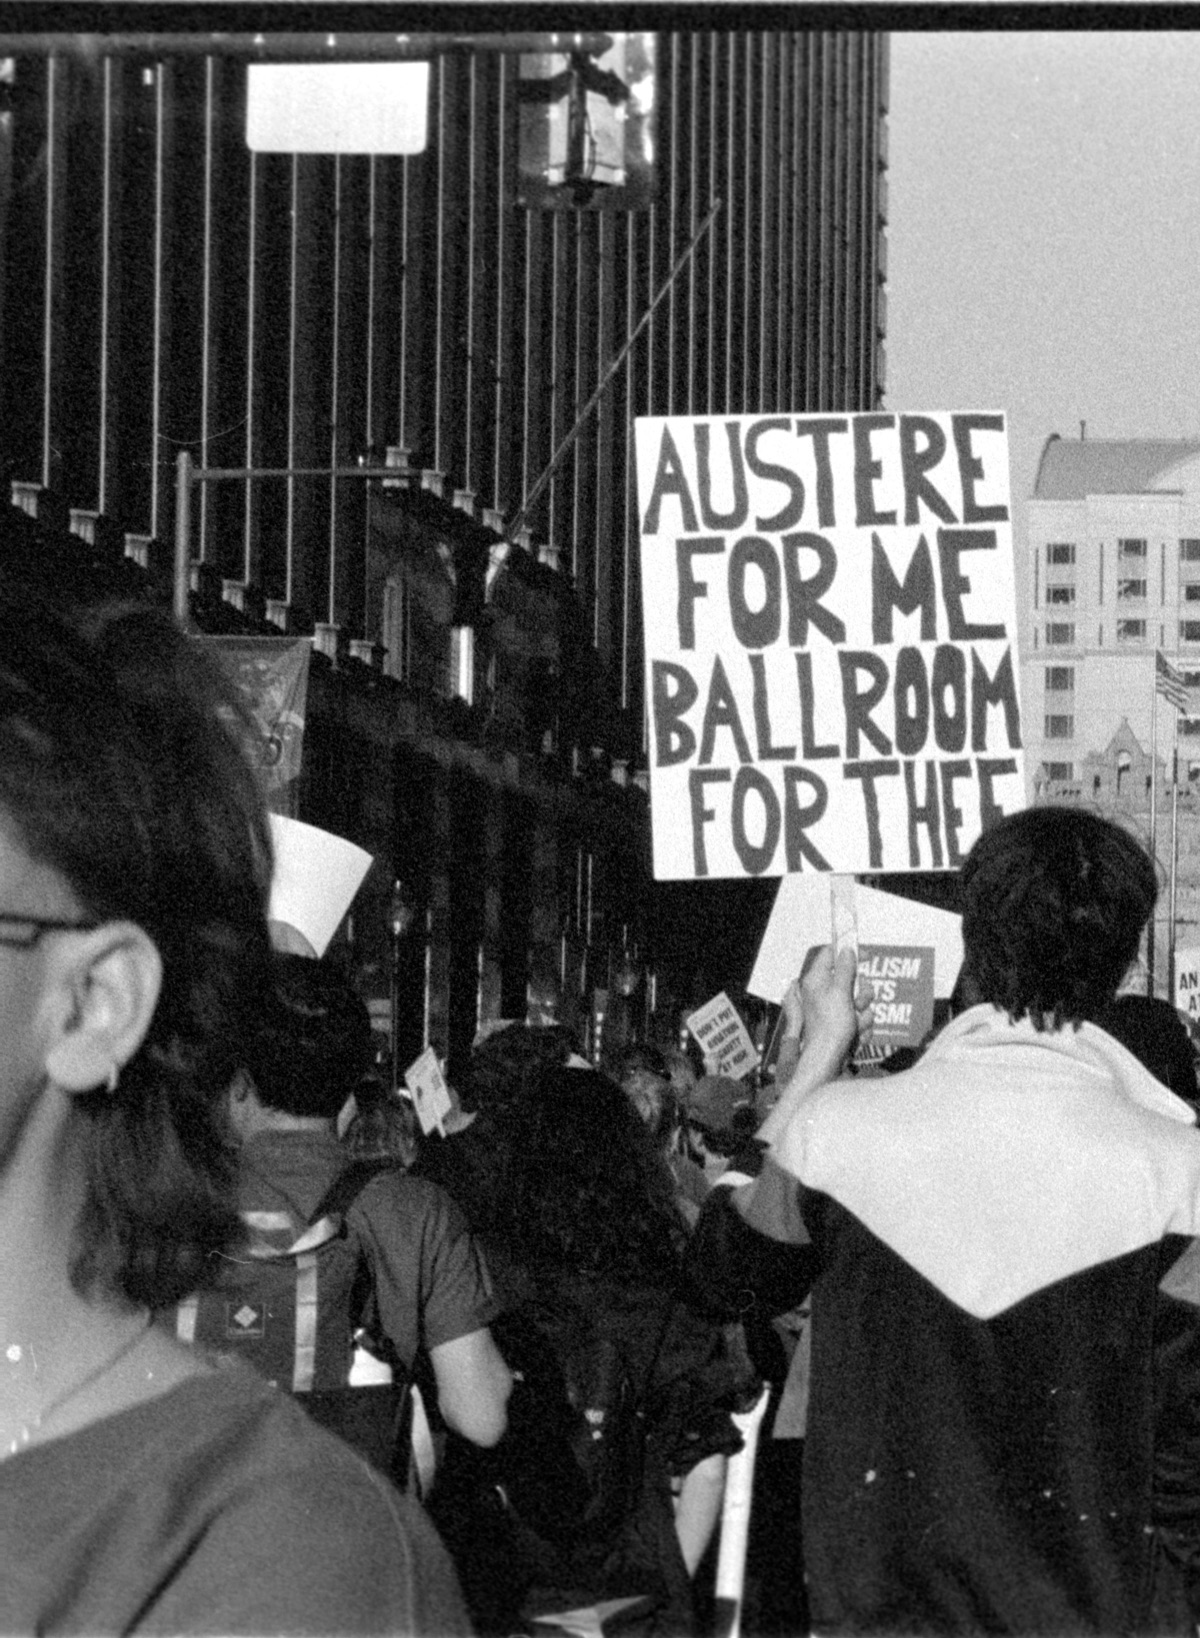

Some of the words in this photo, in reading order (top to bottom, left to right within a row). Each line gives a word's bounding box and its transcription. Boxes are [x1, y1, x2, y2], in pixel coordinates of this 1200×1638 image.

[642, 414, 1009, 535] AUSTERE
[676, 532, 846, 650] FOR
[871, 527, 1007, 645] ME
[652, 644, 1024, 767] BALLROOM
[689, 766, 834, 876] FOR
[1179, 972, 1198, 990] AN
